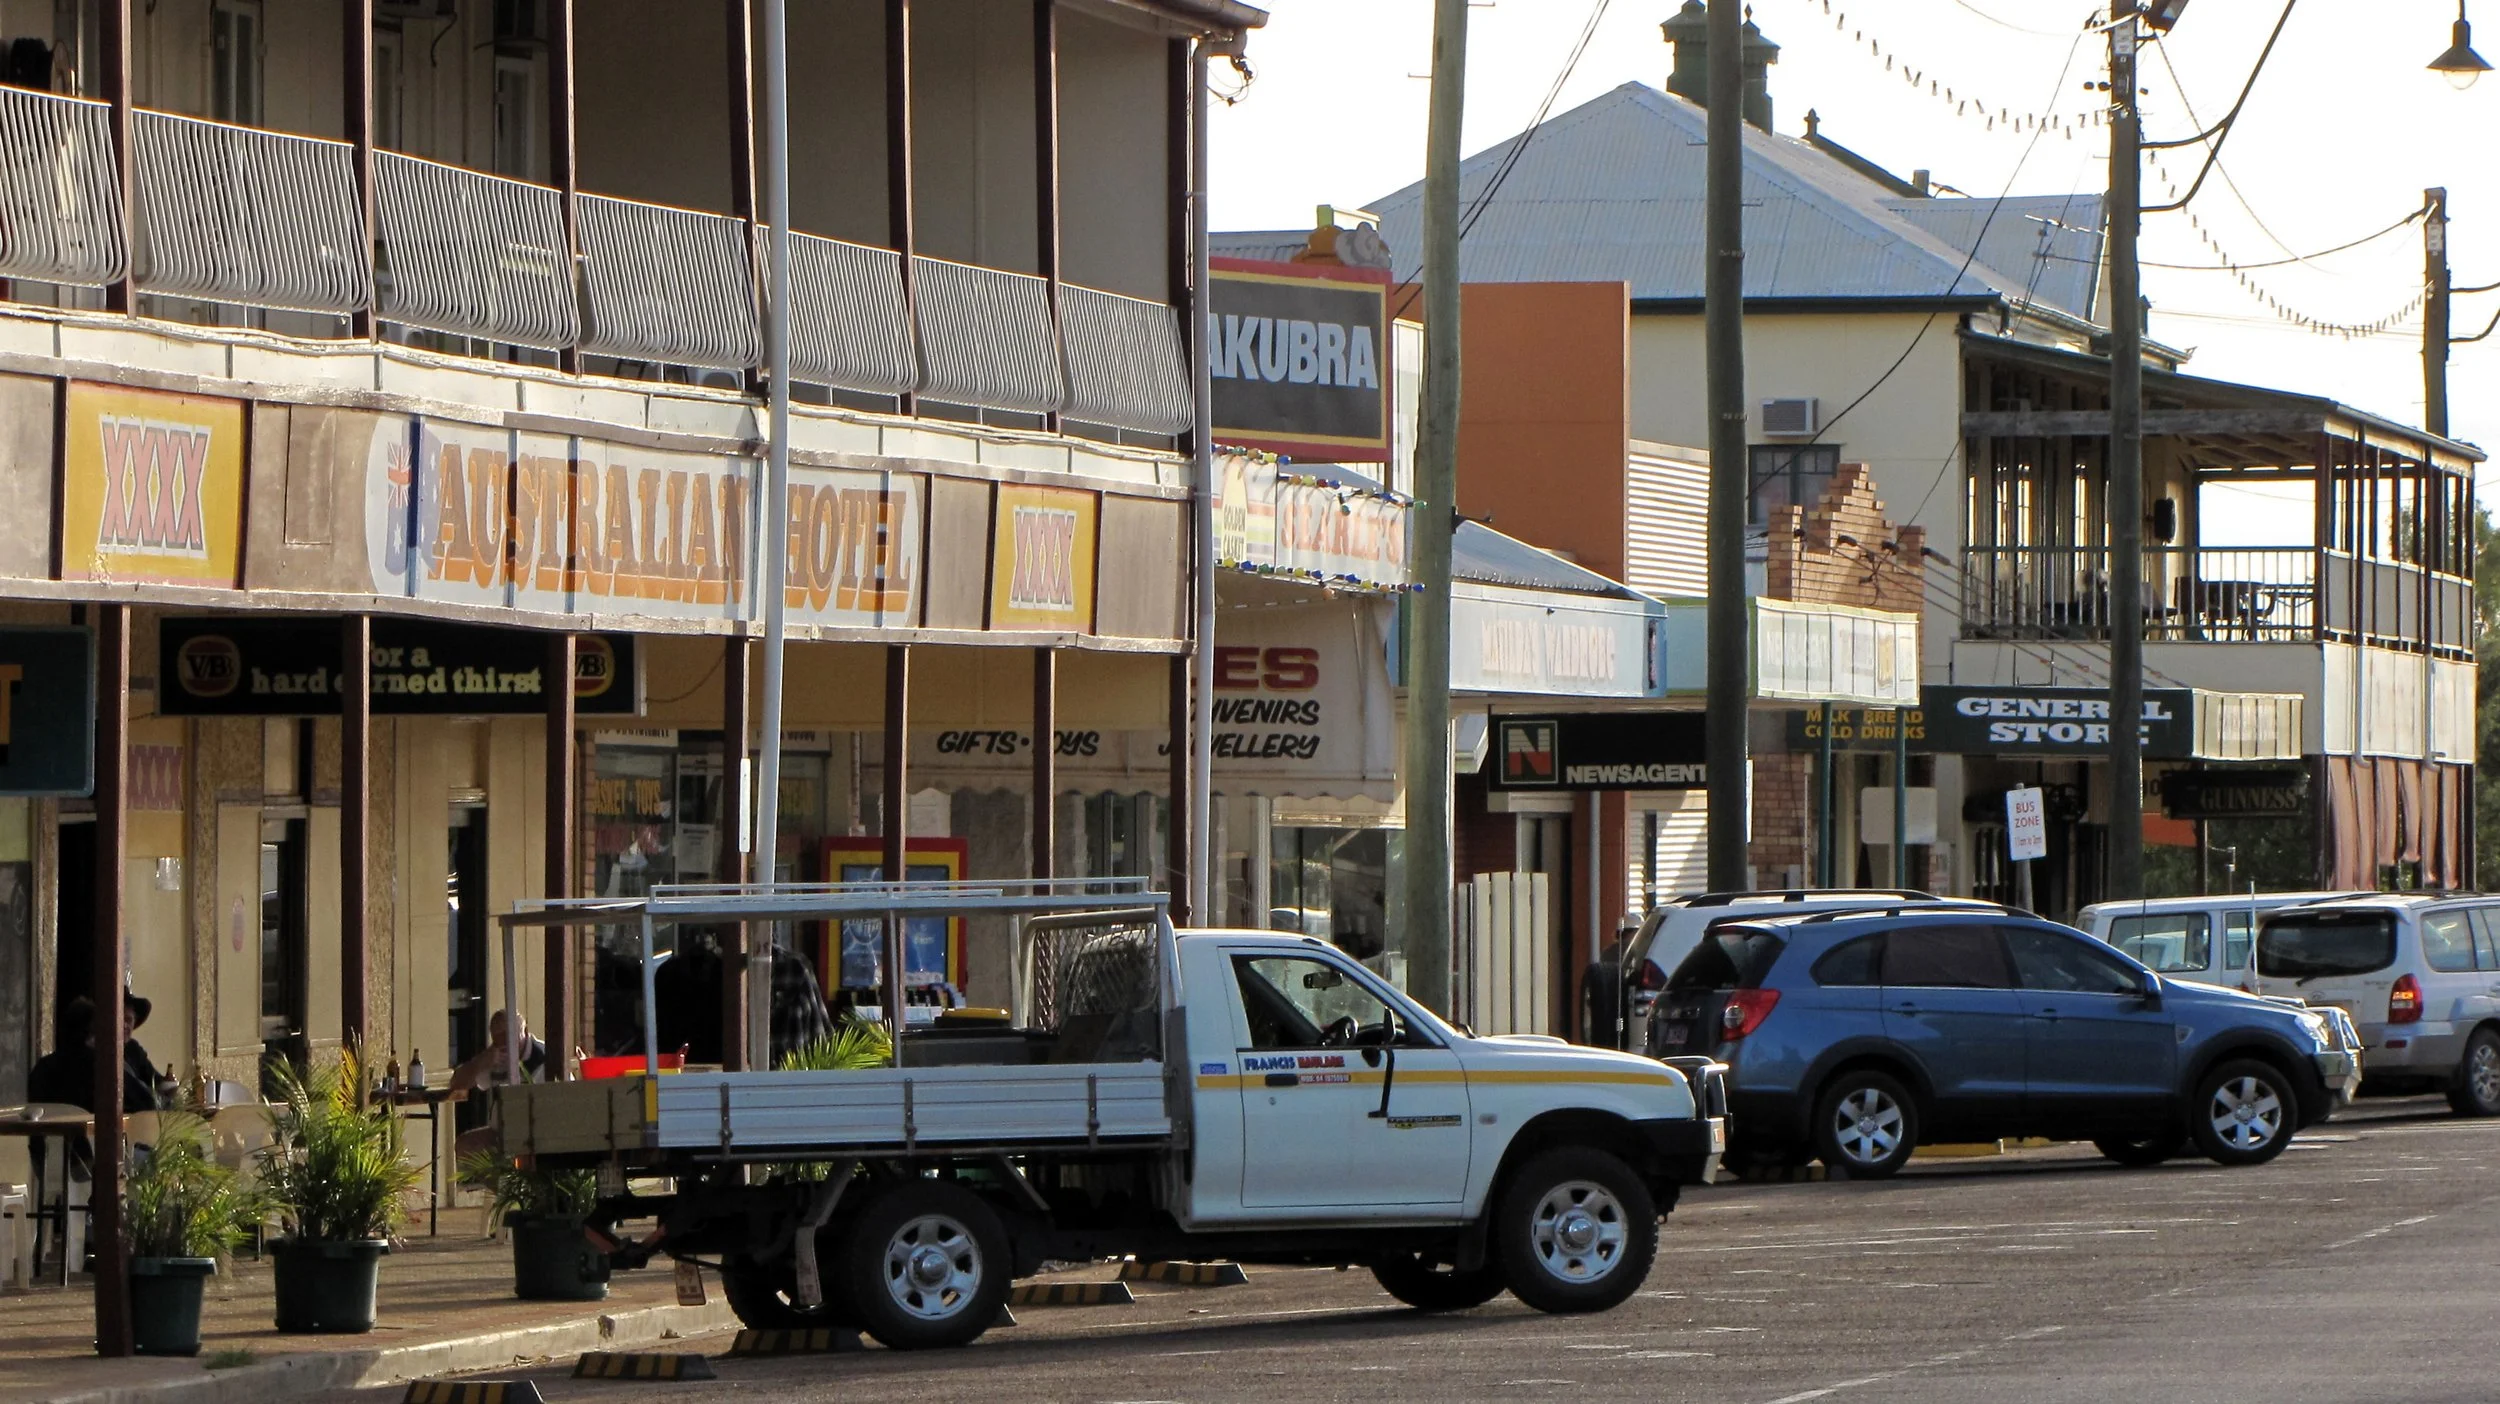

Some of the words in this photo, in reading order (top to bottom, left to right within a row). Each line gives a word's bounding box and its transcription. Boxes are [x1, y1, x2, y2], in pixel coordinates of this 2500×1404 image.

[96, 415, 211, 559] XXXX
[428, 443, 749, 604] AUSTRALIAN
[785, 484, 911, 612] HOTEL
[1009, 506, 1078, 611] XXXX
[186, 653, 236, 680] VB
[410, 647, 431, 668] a
[251, 667, 329, 694] hard
[452, 665, 542, 694] thirst
[1806, 709, 1850, 722] MLK
[1956, 697, 2173, 720] GENERL
[936, 730, 1018, 755] GIFTS
[1804, 725, 1853, 739] CLD
[1566, 764, 1707, 784] NEWSAGENT
[2015, 801, 2035, 814] BUS
[2200, 786, 2298, 810] GUINNESS
[2015, 816, 2040, 828] ZONE
[1244, 1056, 1295, 1071] FRANCIS
